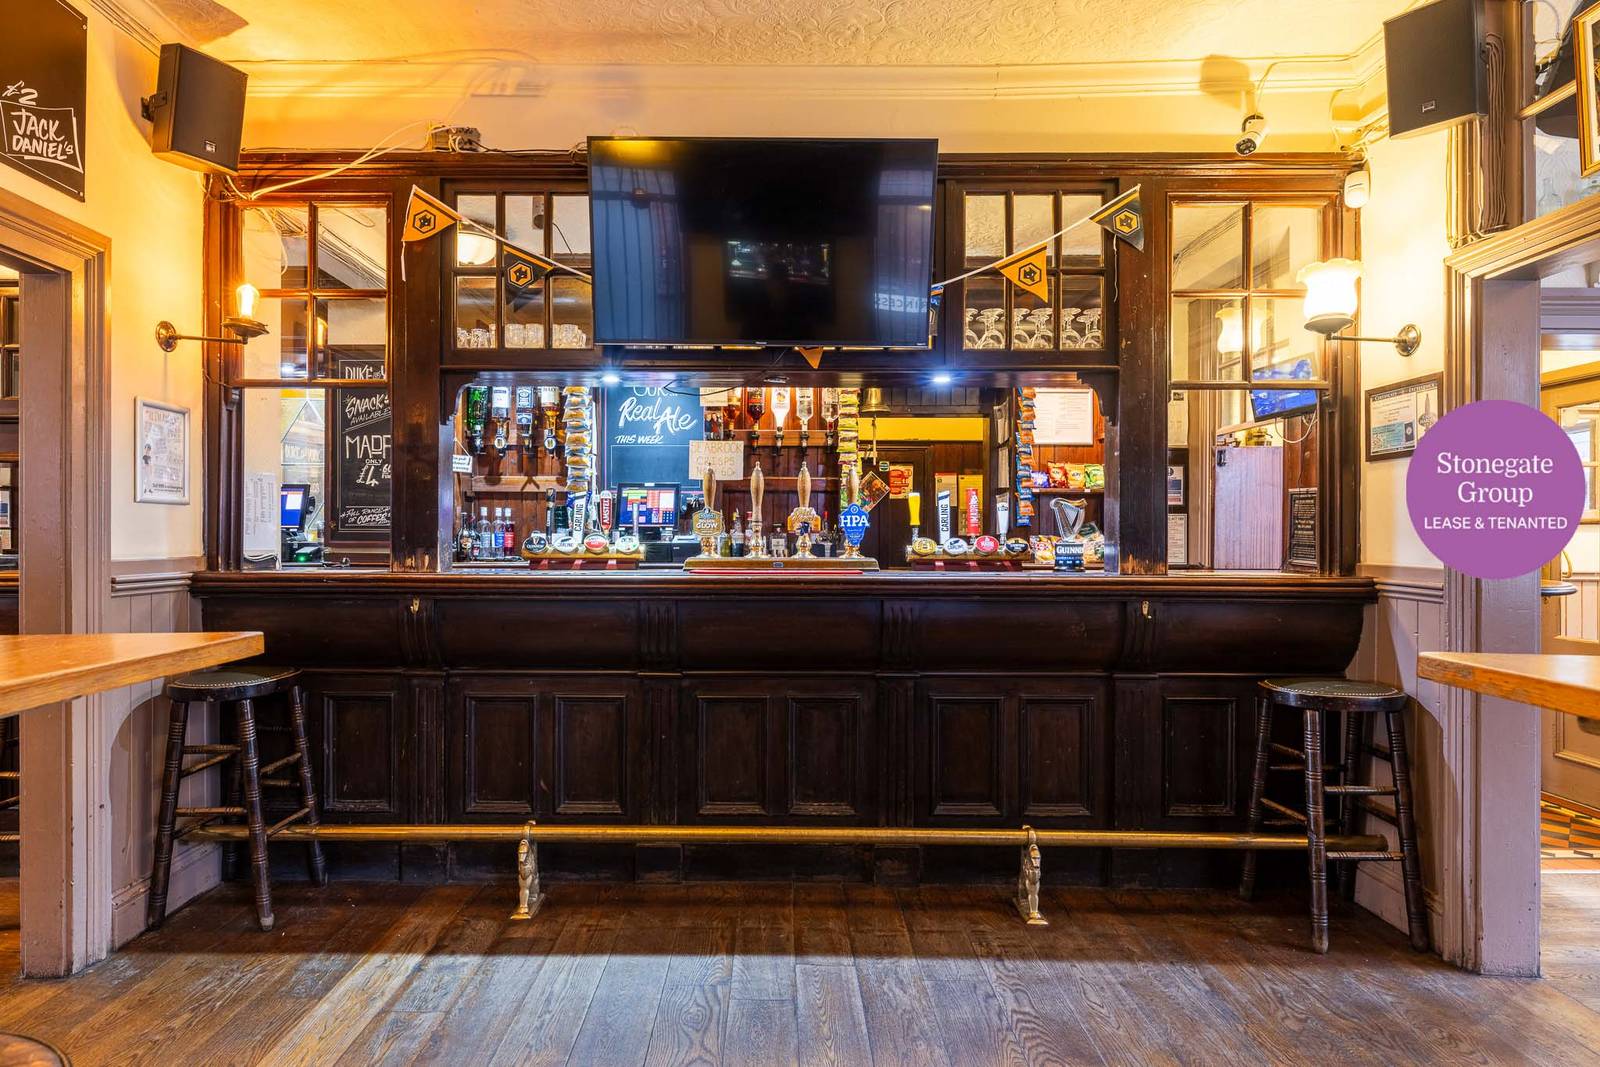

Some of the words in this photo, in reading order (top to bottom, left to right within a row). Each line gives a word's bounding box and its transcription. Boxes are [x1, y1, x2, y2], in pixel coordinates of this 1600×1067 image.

[11, 108, 65, 141] JACK
[618, 396, 661, 428] Real
[653, 405, 698, 436] Ale
[615, 434, 637, 444] THIS
[638, 433, 664, 445] WEEK
[574, 503, 584, 532] CARLING
[840, 515, 870, 527] HPA
[941, 504, 949, 533] CARLING
